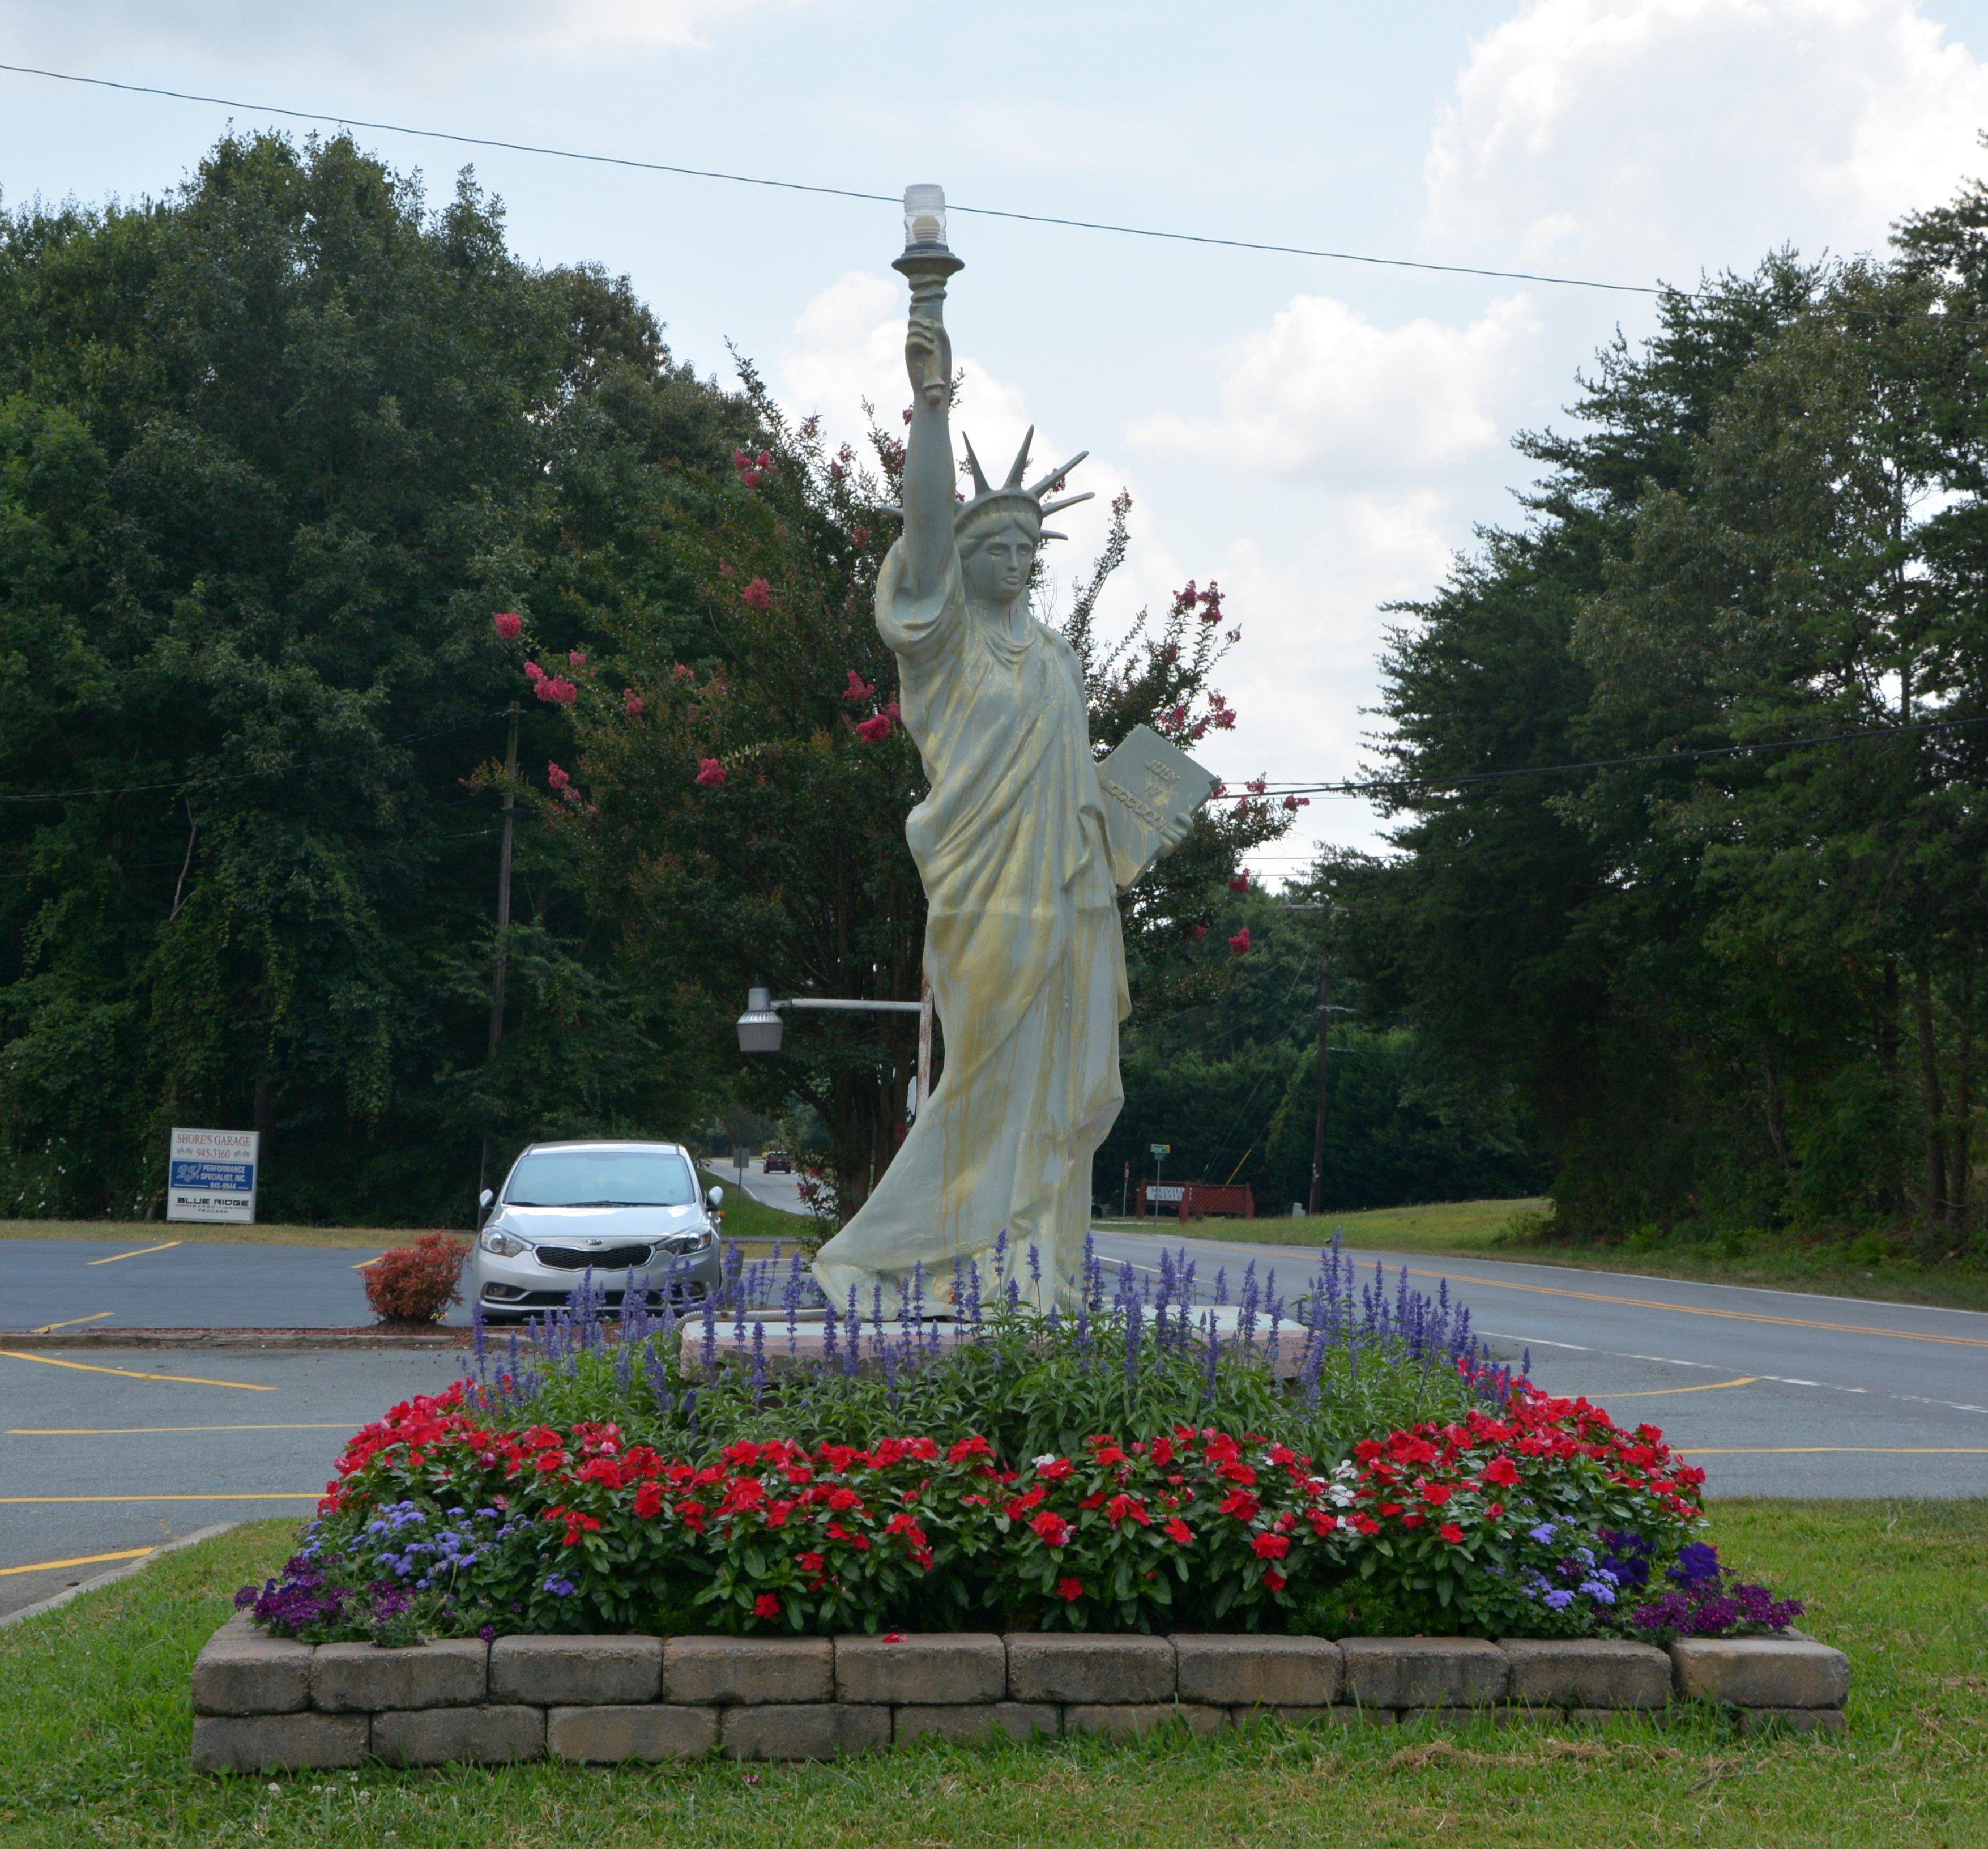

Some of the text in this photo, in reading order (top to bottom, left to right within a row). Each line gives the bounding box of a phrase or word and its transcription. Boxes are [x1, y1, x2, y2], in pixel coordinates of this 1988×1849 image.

[177, 1134, 250, 1147] SHORE'S GARAGE
[196, 1148, 231, 1159] 945-3160
[202, 1164, 245, 1174] PERFORMANCE
